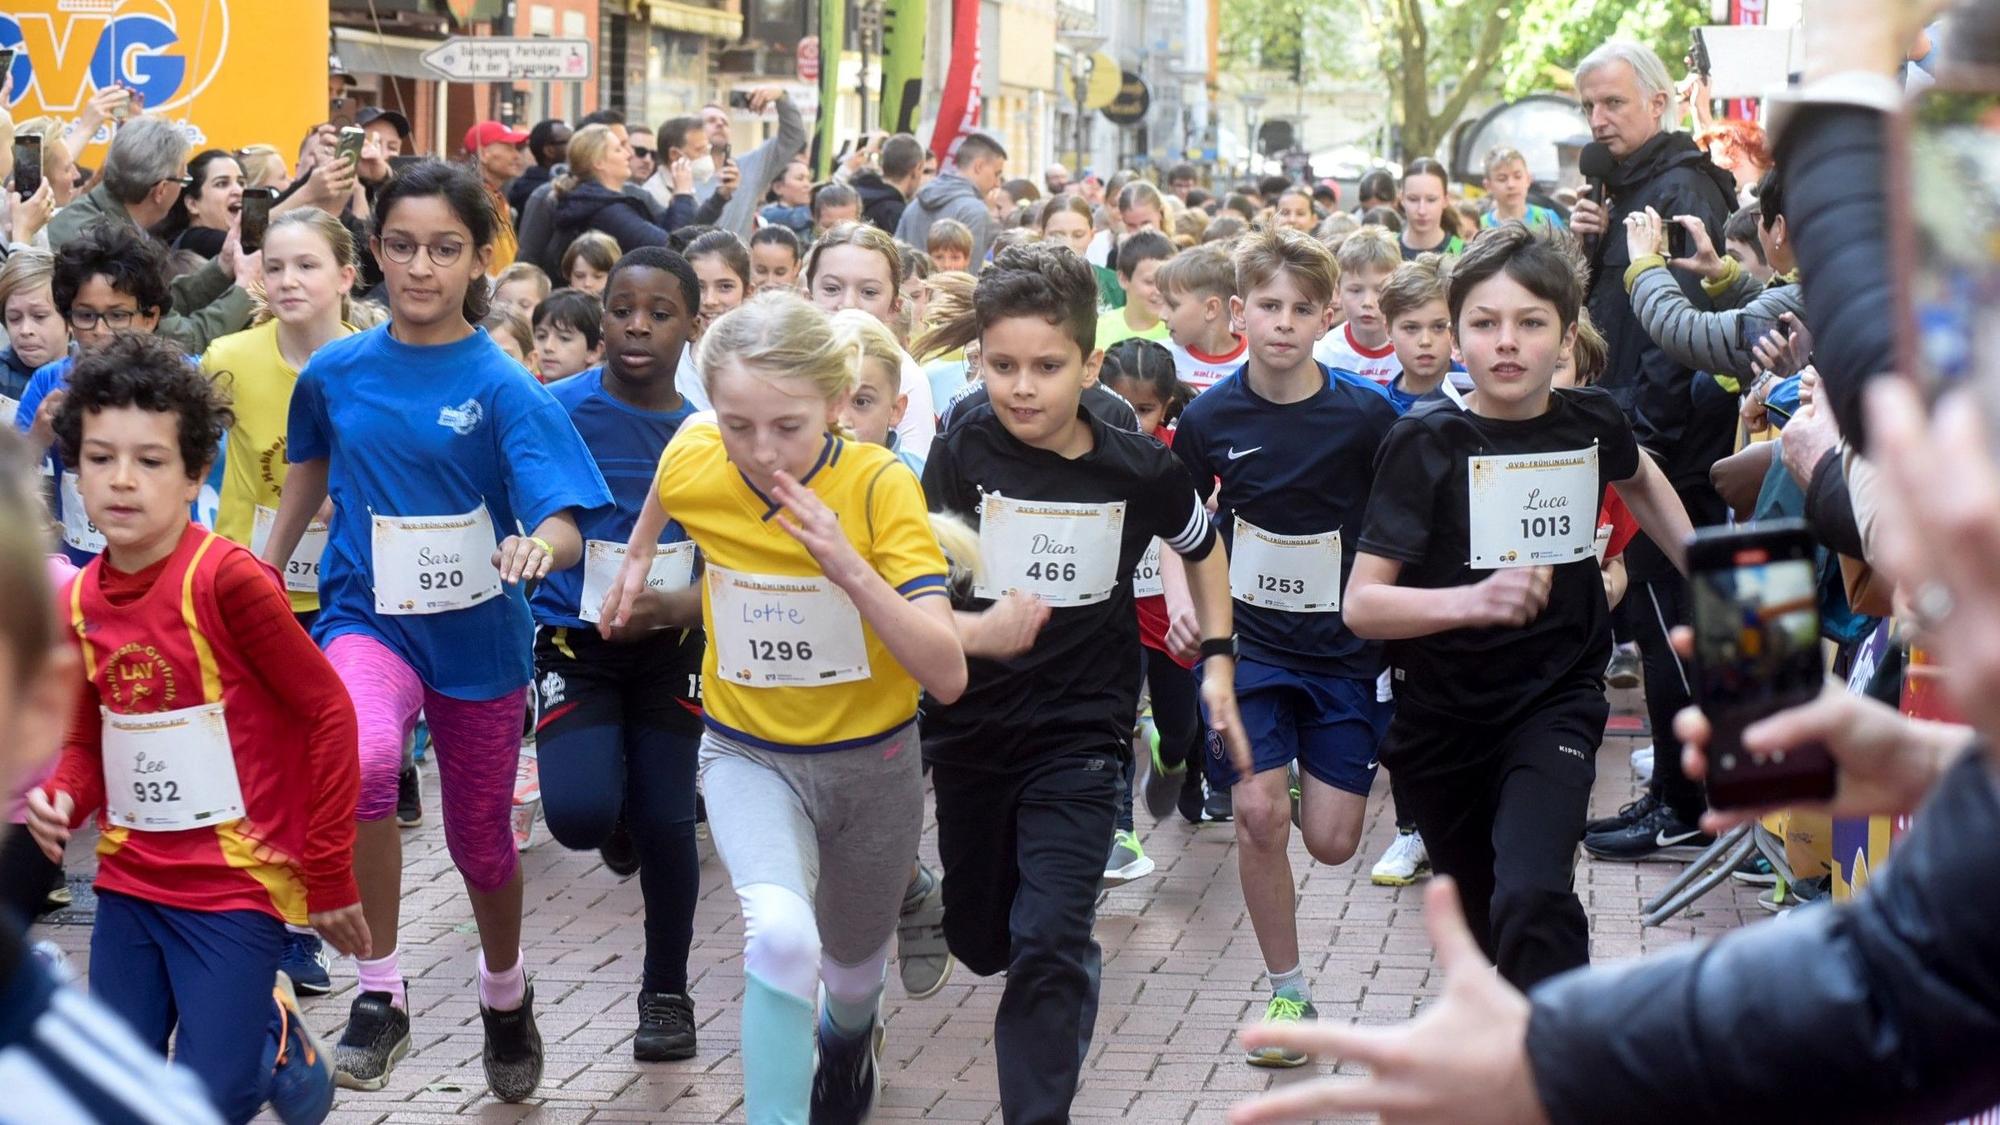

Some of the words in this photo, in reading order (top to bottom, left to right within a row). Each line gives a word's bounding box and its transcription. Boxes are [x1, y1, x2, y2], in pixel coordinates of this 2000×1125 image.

[1523, 488, 1569, 511] Luca
[1521, 515, 1571, 539] 1013
[1031, 533, 1079, 556] Dian
[418, 546, 461, 567] Sara
[420, 570, 463, 590] 920
[1026, 562, 1076, 582] 466
[1257, 574, 1305, 595] 1253
[743, 601, 806, 625] Lotte
[748, 639, 813, 661] 1296
[119, 662, 154, 681] LAV
[133, 751, 167, 775] Leo
[133, 780, 181, 803] 932
